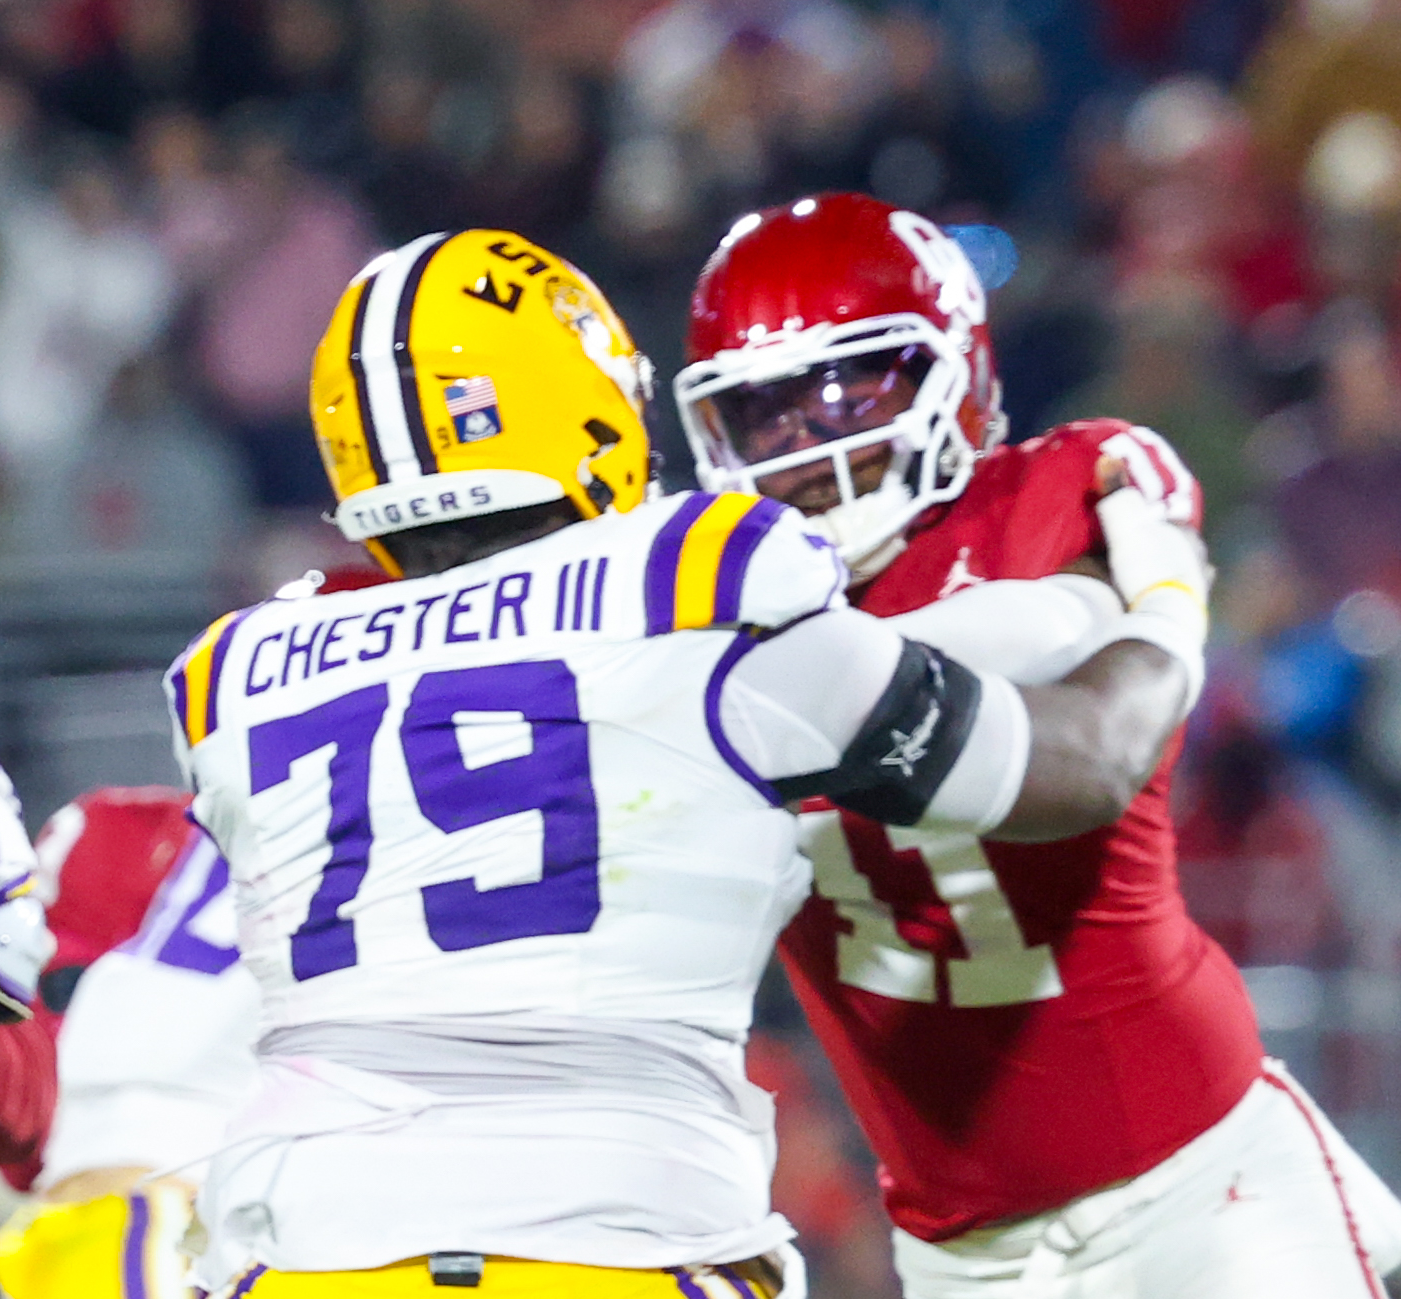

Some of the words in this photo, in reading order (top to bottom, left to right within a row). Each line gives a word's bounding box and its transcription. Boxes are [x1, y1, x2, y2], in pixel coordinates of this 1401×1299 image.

[355, 486, 491, 530] TIGERS
[246, 572, 532, 696] CHESTER
[554, 557, 609, 631] III
[248, 659, 601, 983] 79
[797, 809, 1064, 1008] 11
